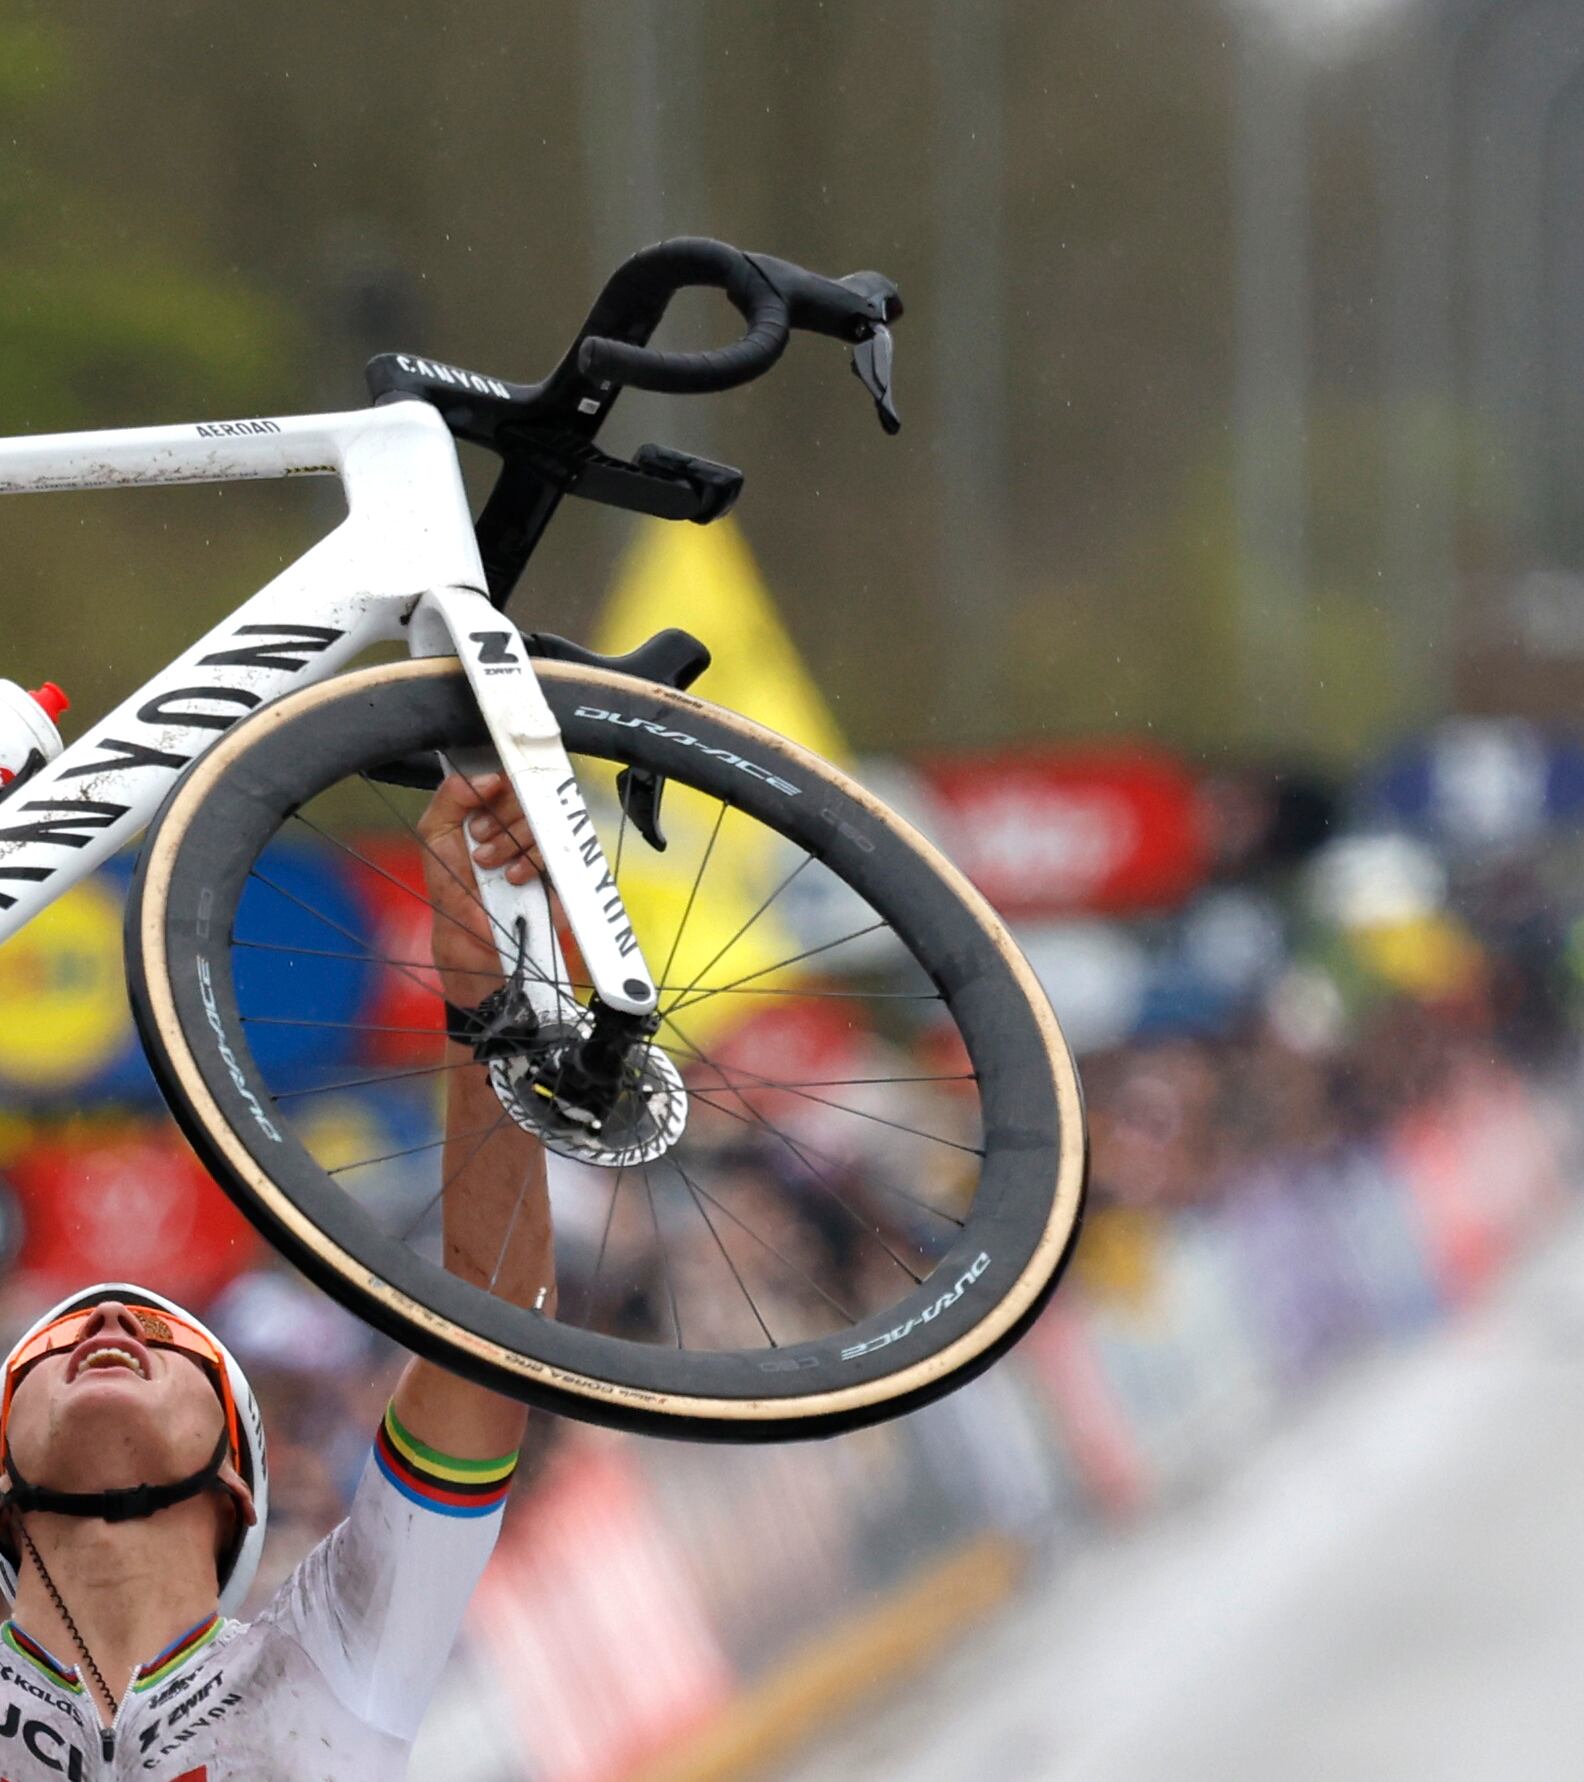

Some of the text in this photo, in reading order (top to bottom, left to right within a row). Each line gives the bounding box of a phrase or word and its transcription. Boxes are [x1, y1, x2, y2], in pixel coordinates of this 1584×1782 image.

[395, 355, 511, 400] CANYON
[195, 420, 281, 440] AEROAD
[574, 705, 803, 798] DURA-ACE
[556, 777, 639, 959] CANYON
[196, 954, 283, 1143] DURA-ACE
[840, 1251, 992, 1362] DURA-ACE
[143, 1692, 244, 1771] CANYON
[167, 1670, 225, 1726] ZWIFT
